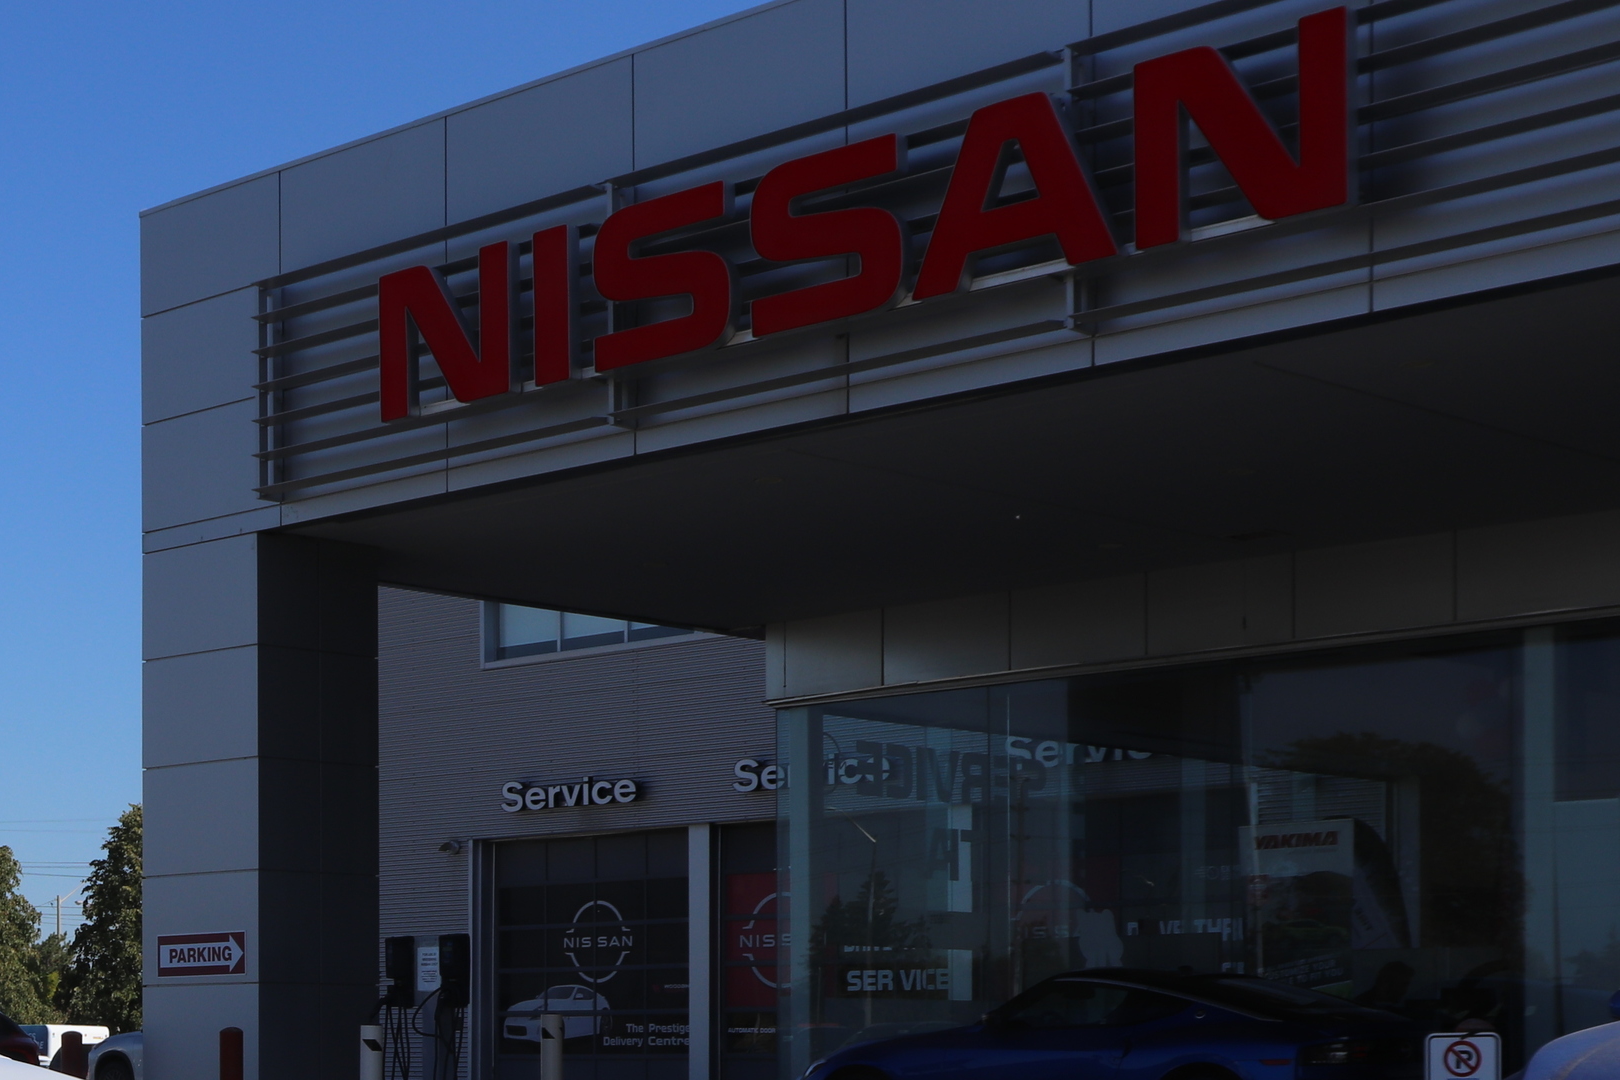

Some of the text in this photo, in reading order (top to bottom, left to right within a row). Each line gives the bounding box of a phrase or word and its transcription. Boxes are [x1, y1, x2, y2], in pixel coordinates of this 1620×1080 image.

[380, 6, 1350, 422] NISSAN
[501, 776, 637, 812] Service
[1255, 831, 1340, 849] YAKIMA
[563, 935, 633, 948] NISSAN
[740, 934, 791, 948] NISS
[169, 946, 232, 963] PARKING
[626, 1023, 644, 1033] The
[603, 1036, 689, 1047] Delivery Centre
